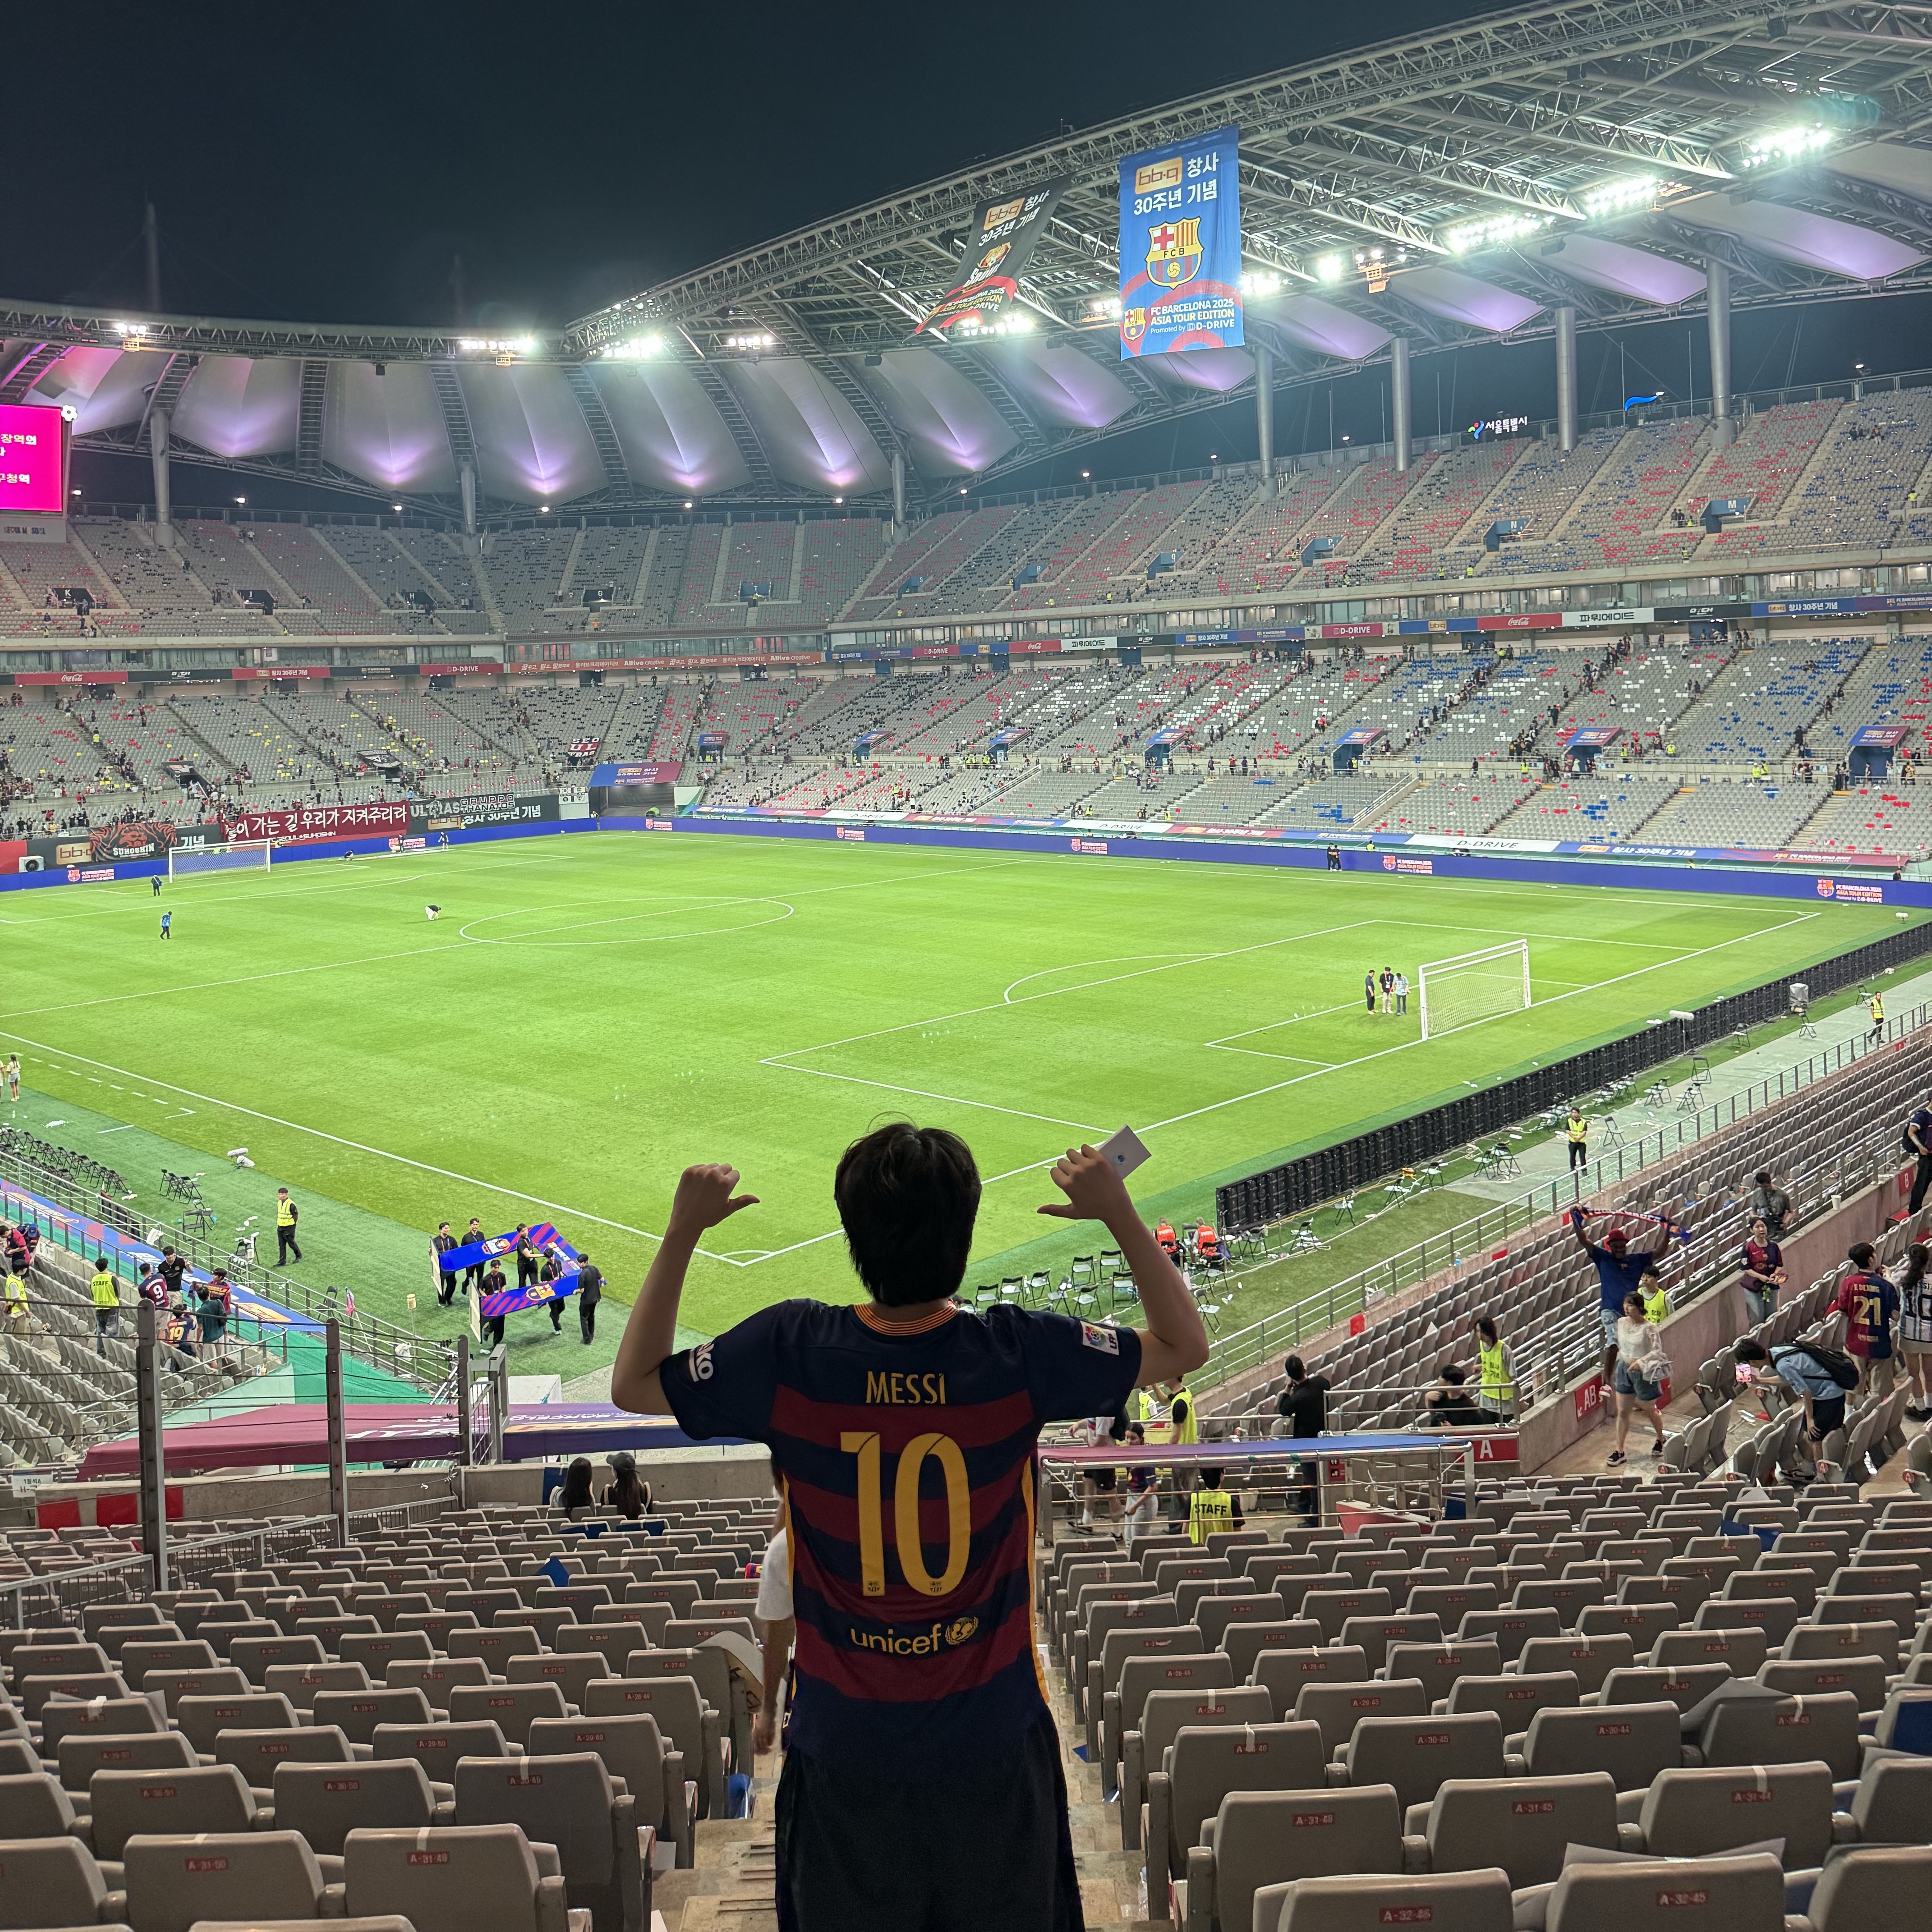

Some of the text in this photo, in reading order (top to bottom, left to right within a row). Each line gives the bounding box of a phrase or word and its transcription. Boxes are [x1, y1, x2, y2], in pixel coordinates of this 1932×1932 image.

[1187, 152, 1219, 178] 창사
[1024, 189, 1050, 211] 창사
[1134, 179, 1217, 215] 30주년 기념
[979, 207, 1040, 246] 30주년 기념
[1164, 248, 1184, 258] FCB
[973, 294, 1003, 303] EDITION
[1151, 298, 1234, 316] FC BARCELONA 2025
[1151, 309, 1234, 326] ASIA TOUR EDITION
[1151, 319, 1235, 334] Promoted by D-DRIVE
[1486, 416, 1527, 434] 서울특별시
[1728, 500, 1736, 509] M
[1511, 521, 1517, 529] N
[1580, 612, 1634, 622] 파워에이드
[460, 794, 515, 806] GRUPPO
[460, 802, 515, 813] THANATOS
[522, 805, 541, 818] 기념
[251, 805, 407, 835] 가는 길 우리가 지켜주리라
[113, 843, 155, 856] SUHOSHIN
[153, 1285, 164, 1299] 9
[1854, 1296, 1881, 1326] 21
[169, 1326, 184, 1340] 19
[1108, 1333, 1117, 1349] LFP
[866, 1371, 947, 1404] MESSI
[1584, 1384, 1596, 1410] AB
[1480, 1440, 1493, 1459] A
[841, 1432, 971, 1596] 10
[1195, 1504, 1227, 1515] STAFF
[850, 1624, 942, 1655] unicef
